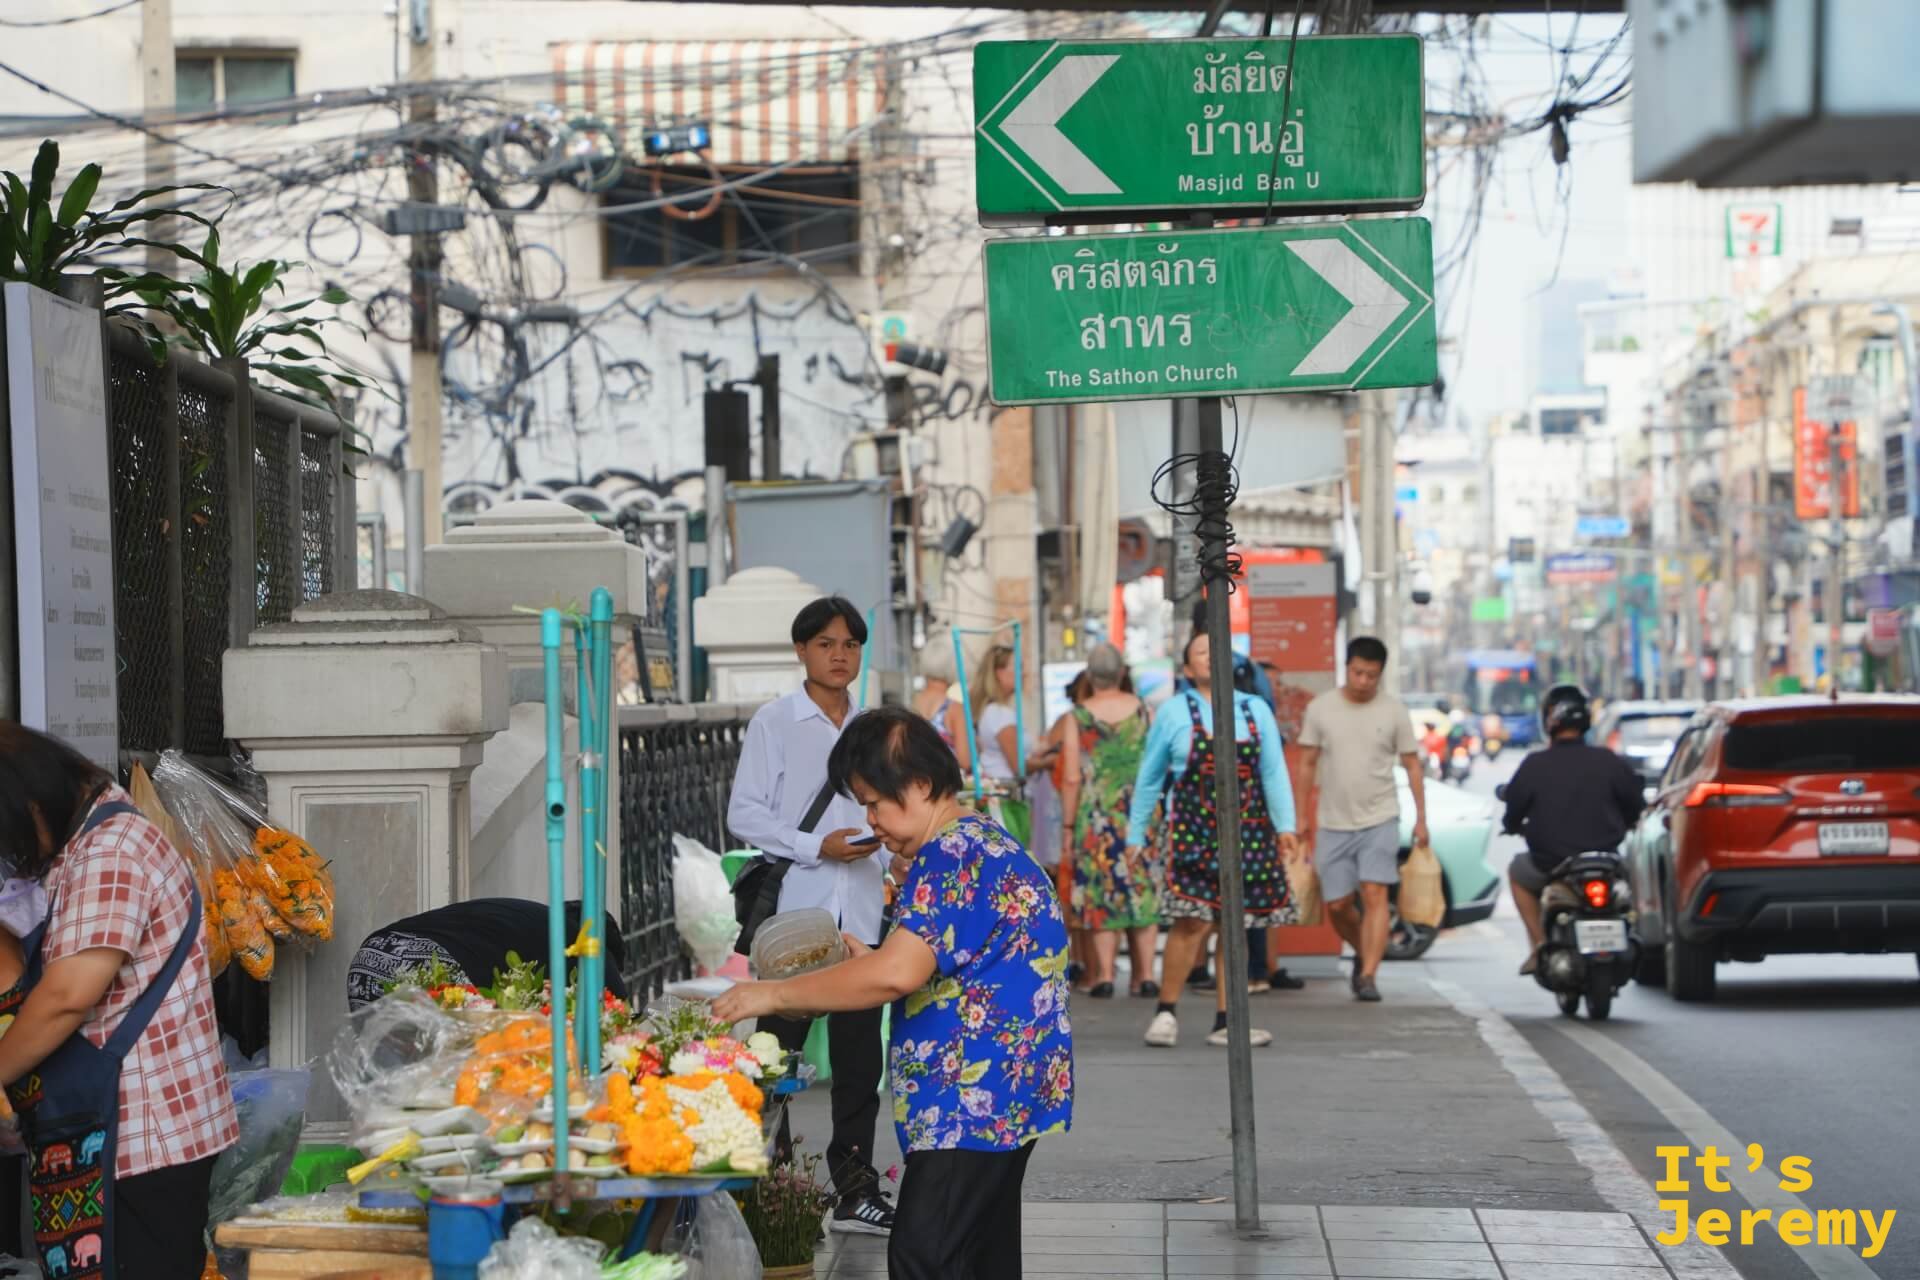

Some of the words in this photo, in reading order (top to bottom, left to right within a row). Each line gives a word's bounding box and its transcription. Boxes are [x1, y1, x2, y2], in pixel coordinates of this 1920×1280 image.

[1193, 51, 1293, 93] มัสยิด
[1186, 104, 1304, 167] บ้านอู่
[1178, 173, 1243, 195] Masjid
[1257, 173, 1295, 191] Ban
[1306, 171, 1320, 189] U
[1051, 243, 1217, 291] คริสตจักร
[1080, 313, 1192, 350] สาทร
[1045, 370, 1082, 387] The
[1089, 367, 1159, 386] Sathon
[1165, 362, 1238, 382] Church
